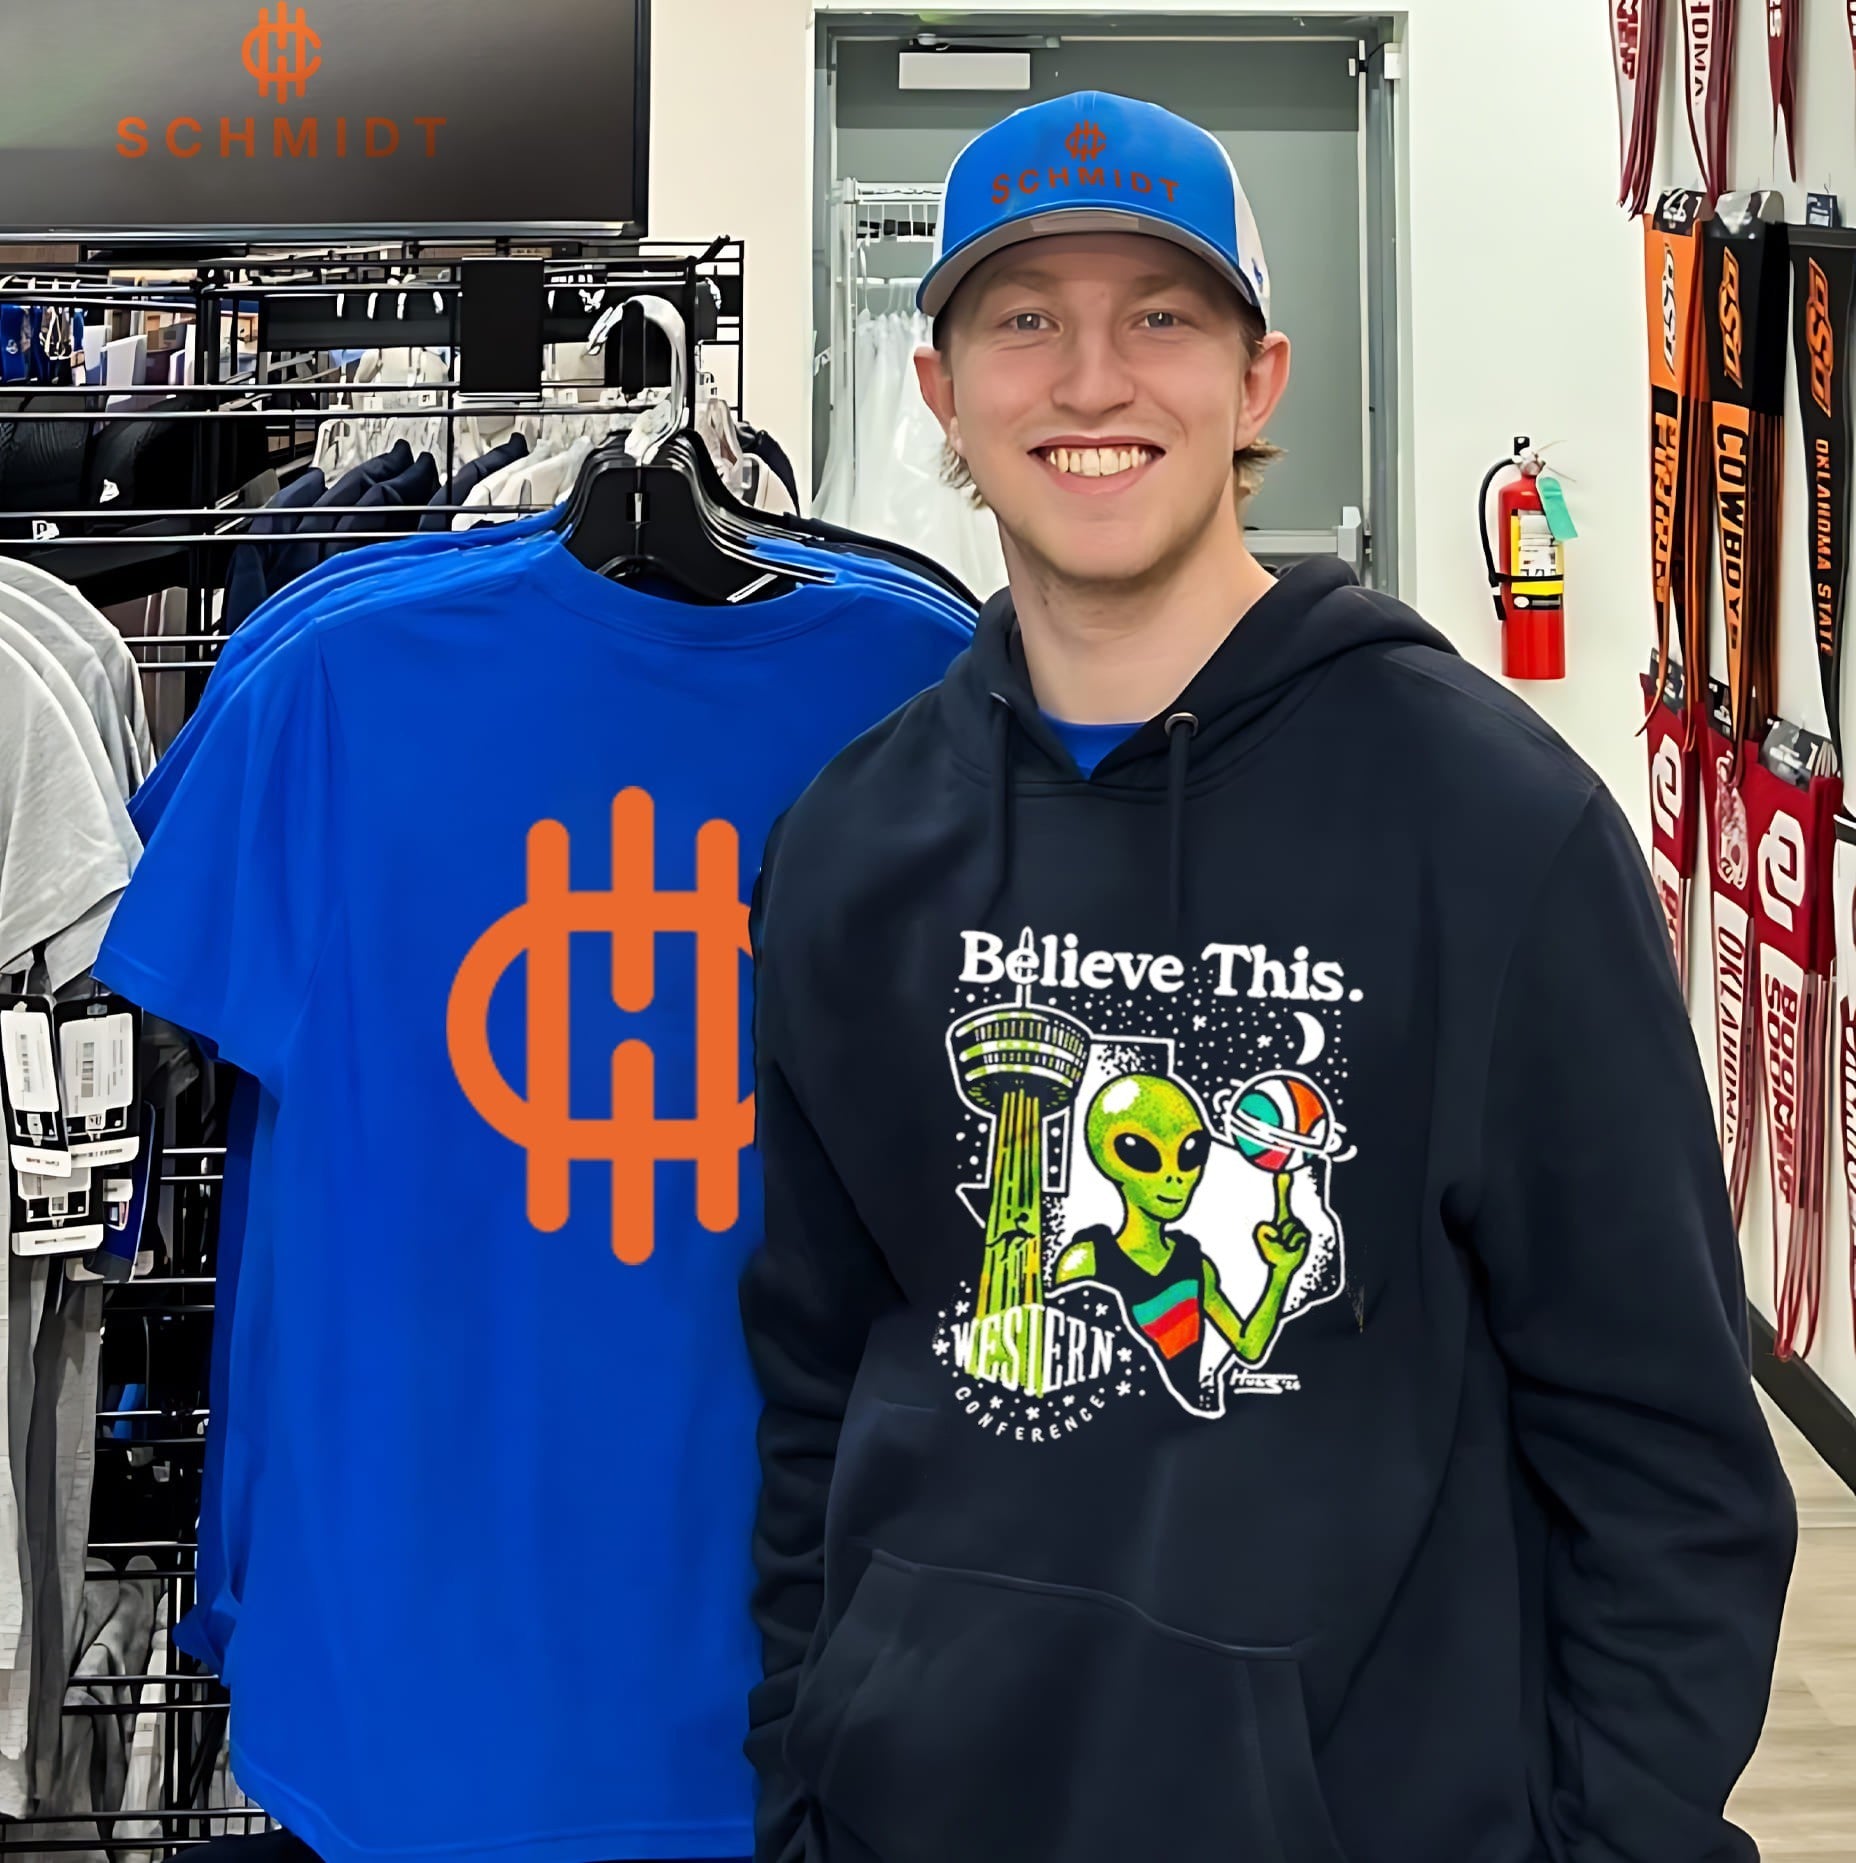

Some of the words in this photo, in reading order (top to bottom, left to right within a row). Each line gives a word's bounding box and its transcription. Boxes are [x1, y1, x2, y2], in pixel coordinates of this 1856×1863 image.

[116, 117, 447, 158] SCHMIDT
[991, 166, 1180, 205] SCHMIDT
[1815, 439, 1832, 570] OKLAHOMA
[958, 928, 1185, 993] Believe
[1201, 943, 1364, 1002] This.
[950, 1303, 1116, 1396] WESTERN
[954, 1386, 1105, 1443] CONFERENCE
